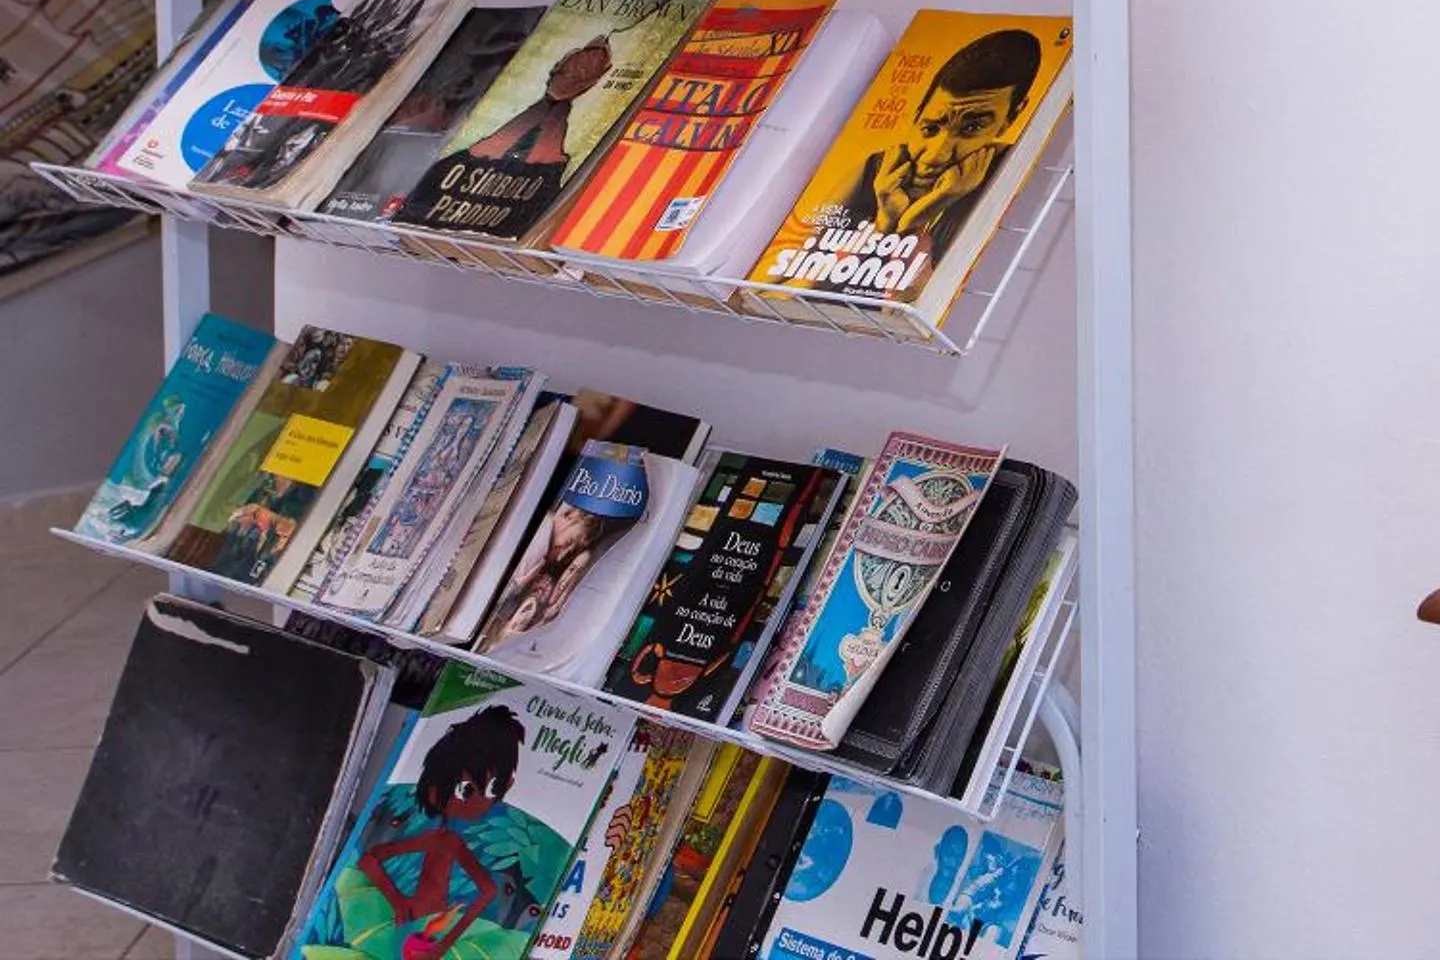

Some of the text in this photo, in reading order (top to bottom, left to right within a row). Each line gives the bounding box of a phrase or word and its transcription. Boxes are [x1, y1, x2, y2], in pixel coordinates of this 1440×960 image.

[656, 78, 769, 116] ITALO
[862, 112, 901, 130] TEM
[440, 163, 545, 201] O SÍMBOLO
[427, 194, 512, 227] PERDIDO
[819, 220, 919, 258] wilson
[767, 236, 928, 291] simonal
[568, 467, 643, 506] Pão Diário
[723, 531, 761, 556] Deus
[676, 622, 715, 650] Deus
[561, 859, 587, 894] A
[779, 931, 825, 960] Sistema
